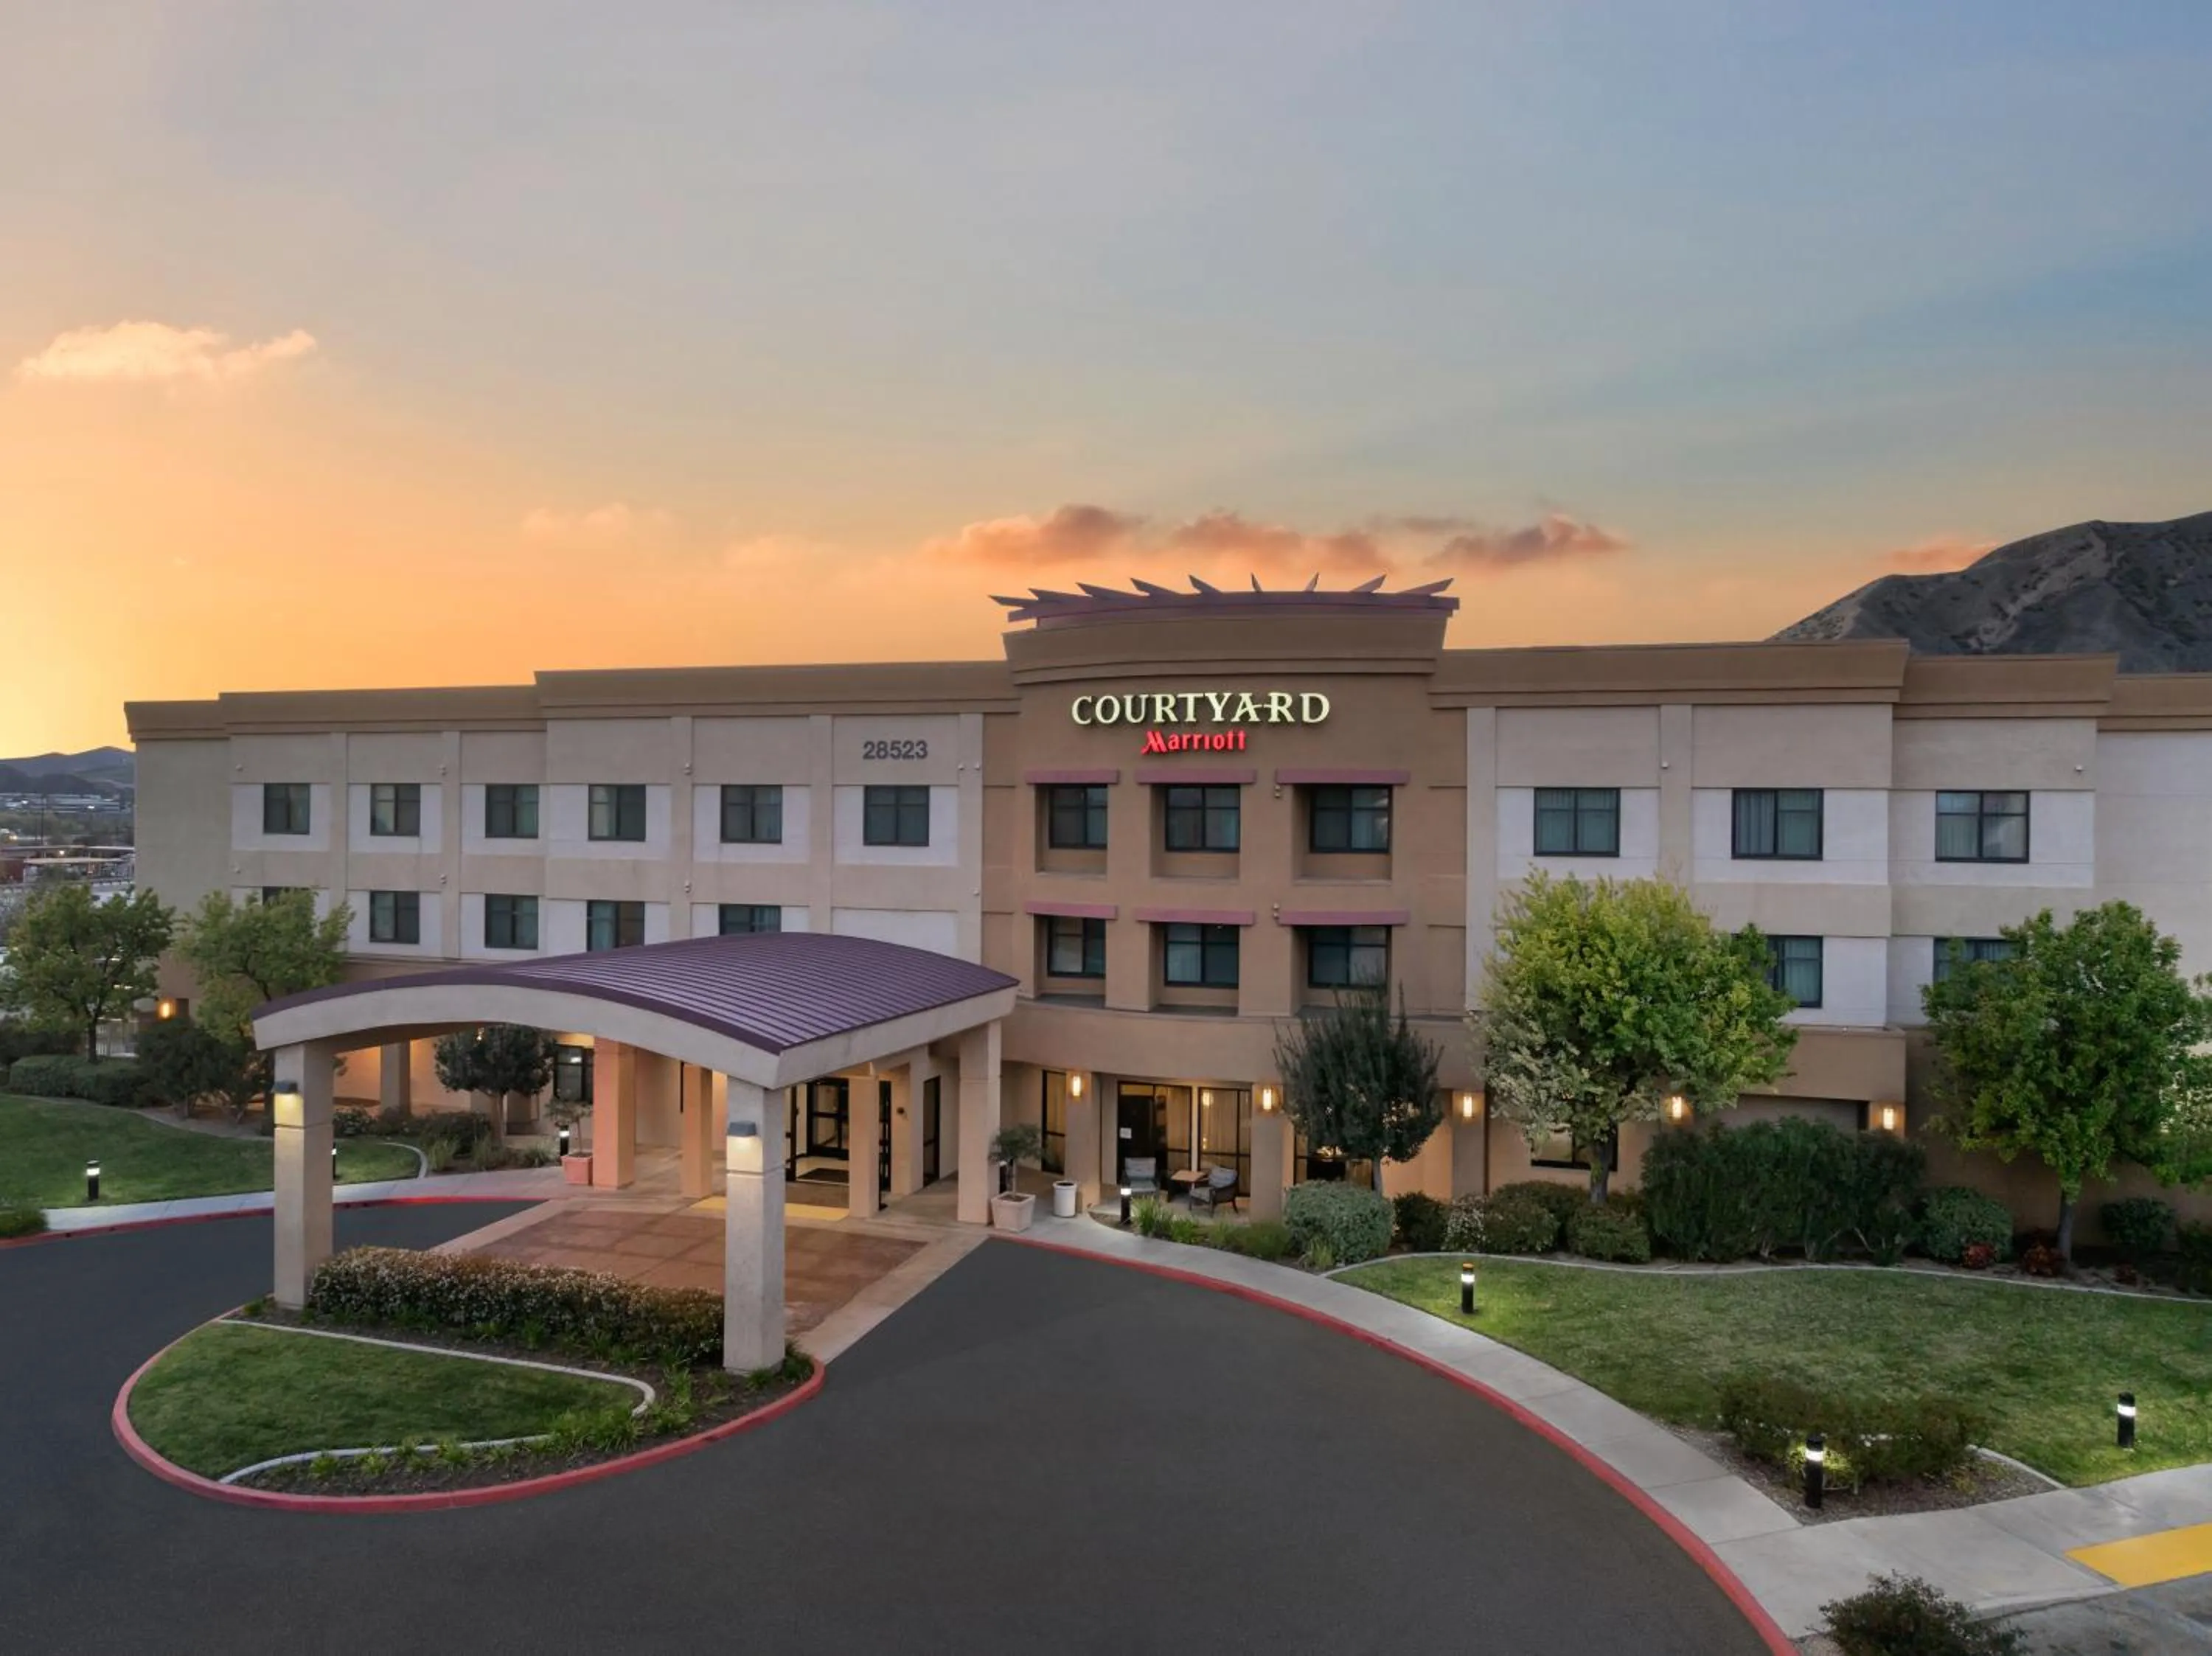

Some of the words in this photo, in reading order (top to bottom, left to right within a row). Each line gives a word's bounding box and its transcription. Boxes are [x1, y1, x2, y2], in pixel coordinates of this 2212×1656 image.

[1071, 692, 1330, 725] COURTYARD
[863, 740, 928, 759] 28523
[1141, 729, 1246, 755] Marriott
